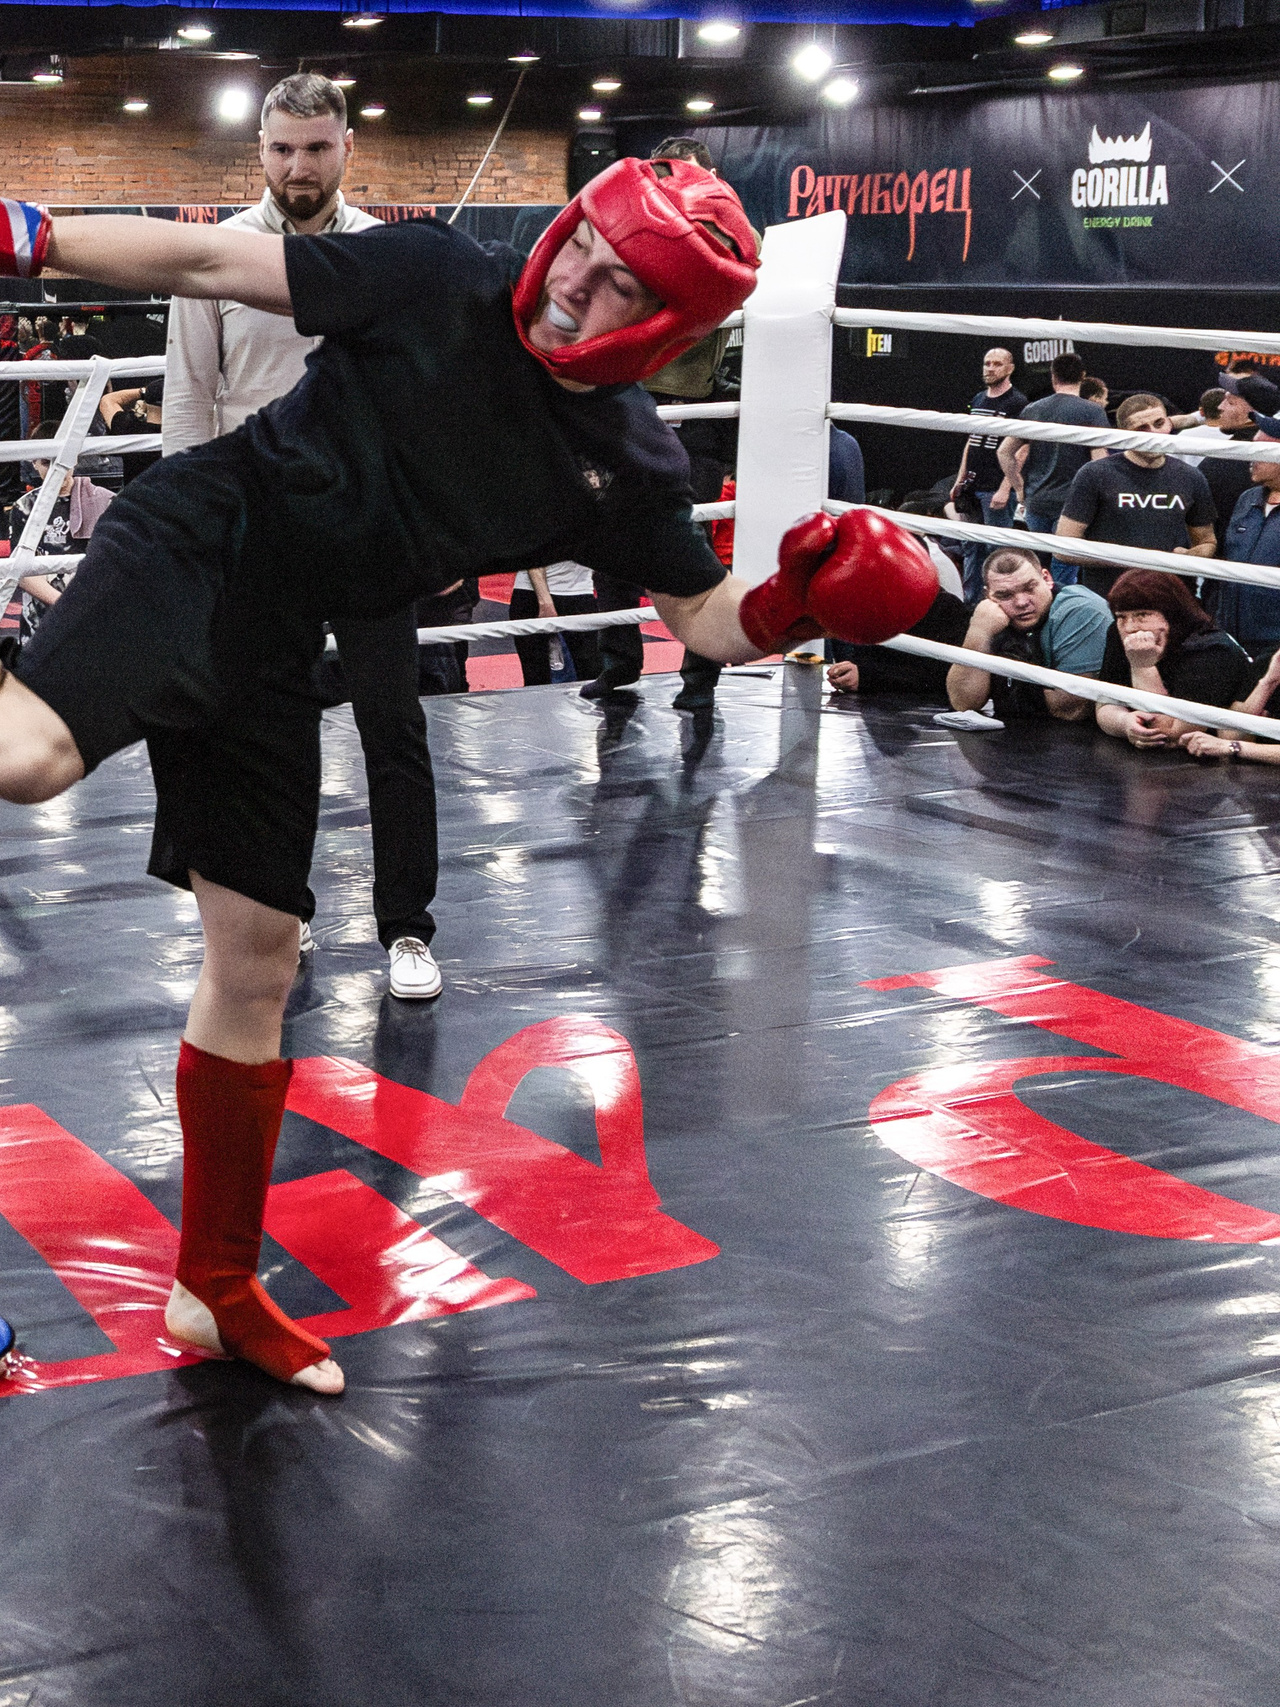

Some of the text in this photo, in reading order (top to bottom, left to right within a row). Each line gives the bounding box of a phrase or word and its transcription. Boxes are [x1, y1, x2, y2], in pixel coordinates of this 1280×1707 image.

[1071, 164, 1169, 209] GORILLA
[1083, 216, 1153, 228] ENERGY DRINK
[1118, 493, 1185, 511] RVCA
